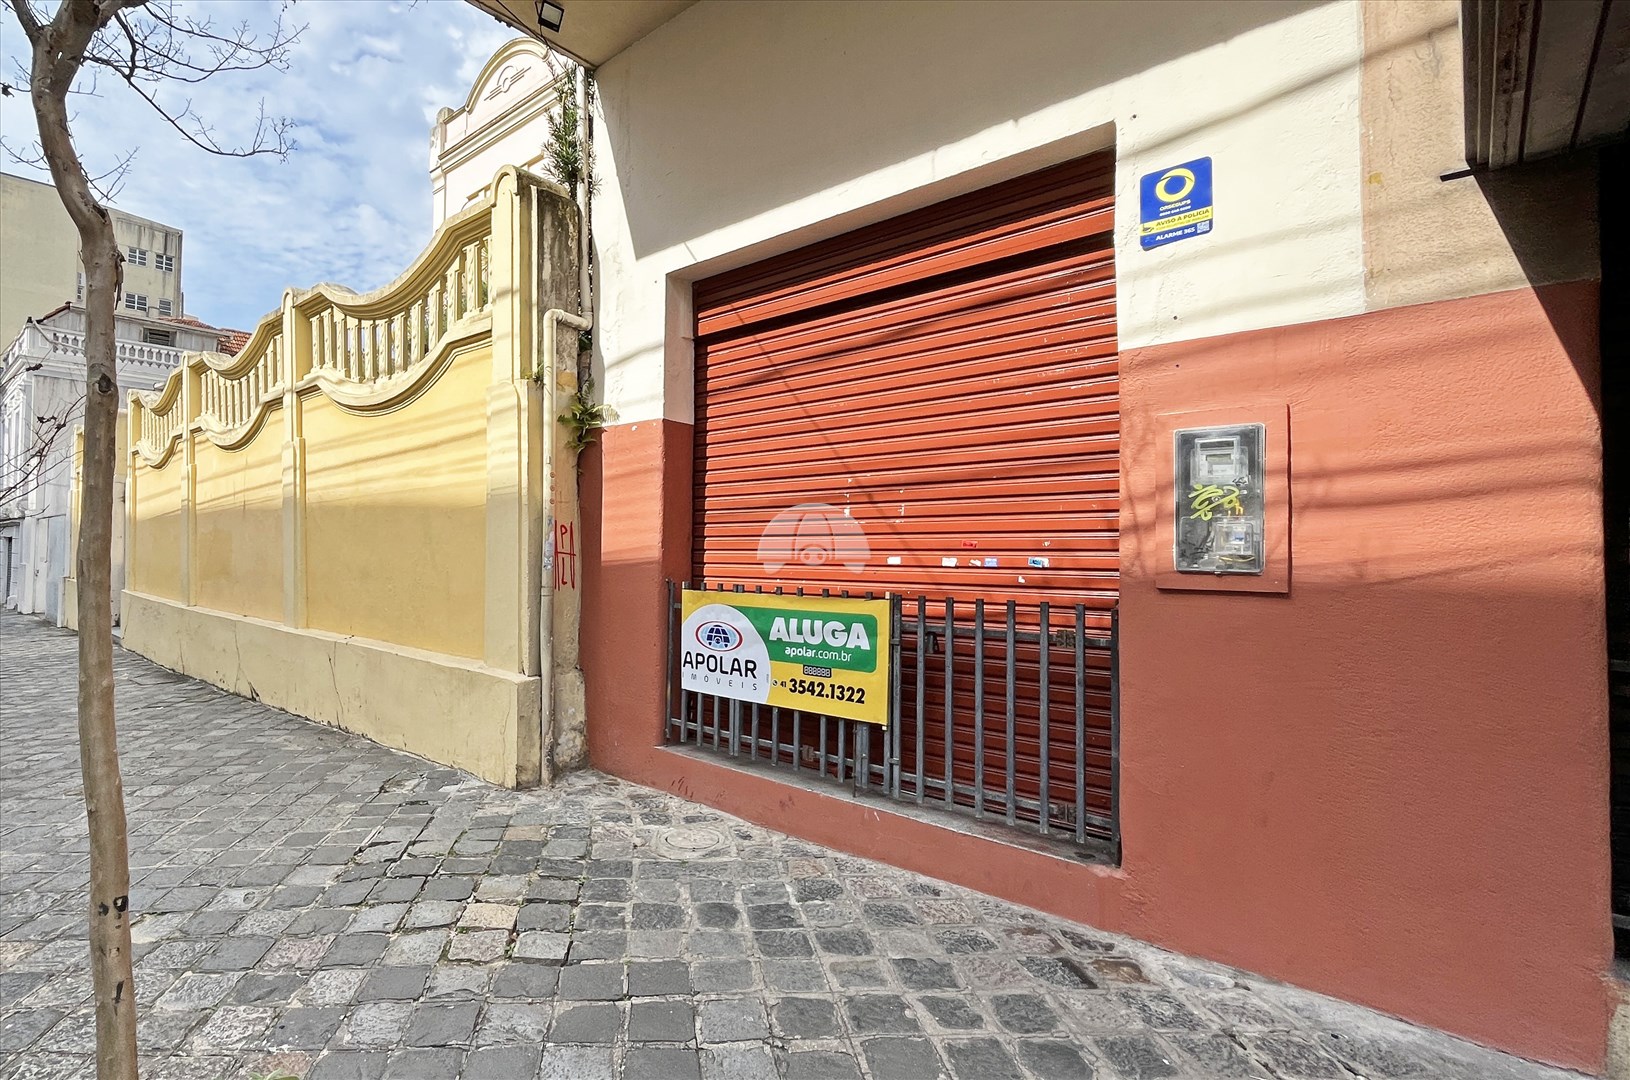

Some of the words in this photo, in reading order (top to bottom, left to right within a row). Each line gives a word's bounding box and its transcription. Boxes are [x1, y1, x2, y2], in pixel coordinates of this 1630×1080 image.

[1155, 217, 1176, 227] AVISO
[1155, 229, 1183, 241] ALARME
[769, 616, 870, 650] ALUGA
[784, 646, 852, 662] apolar.com.br
[683, 651, 757, 679] APOLAR
[779, 680, 787, 688] 41
[788, 678, 866, 704] 3542.1322
